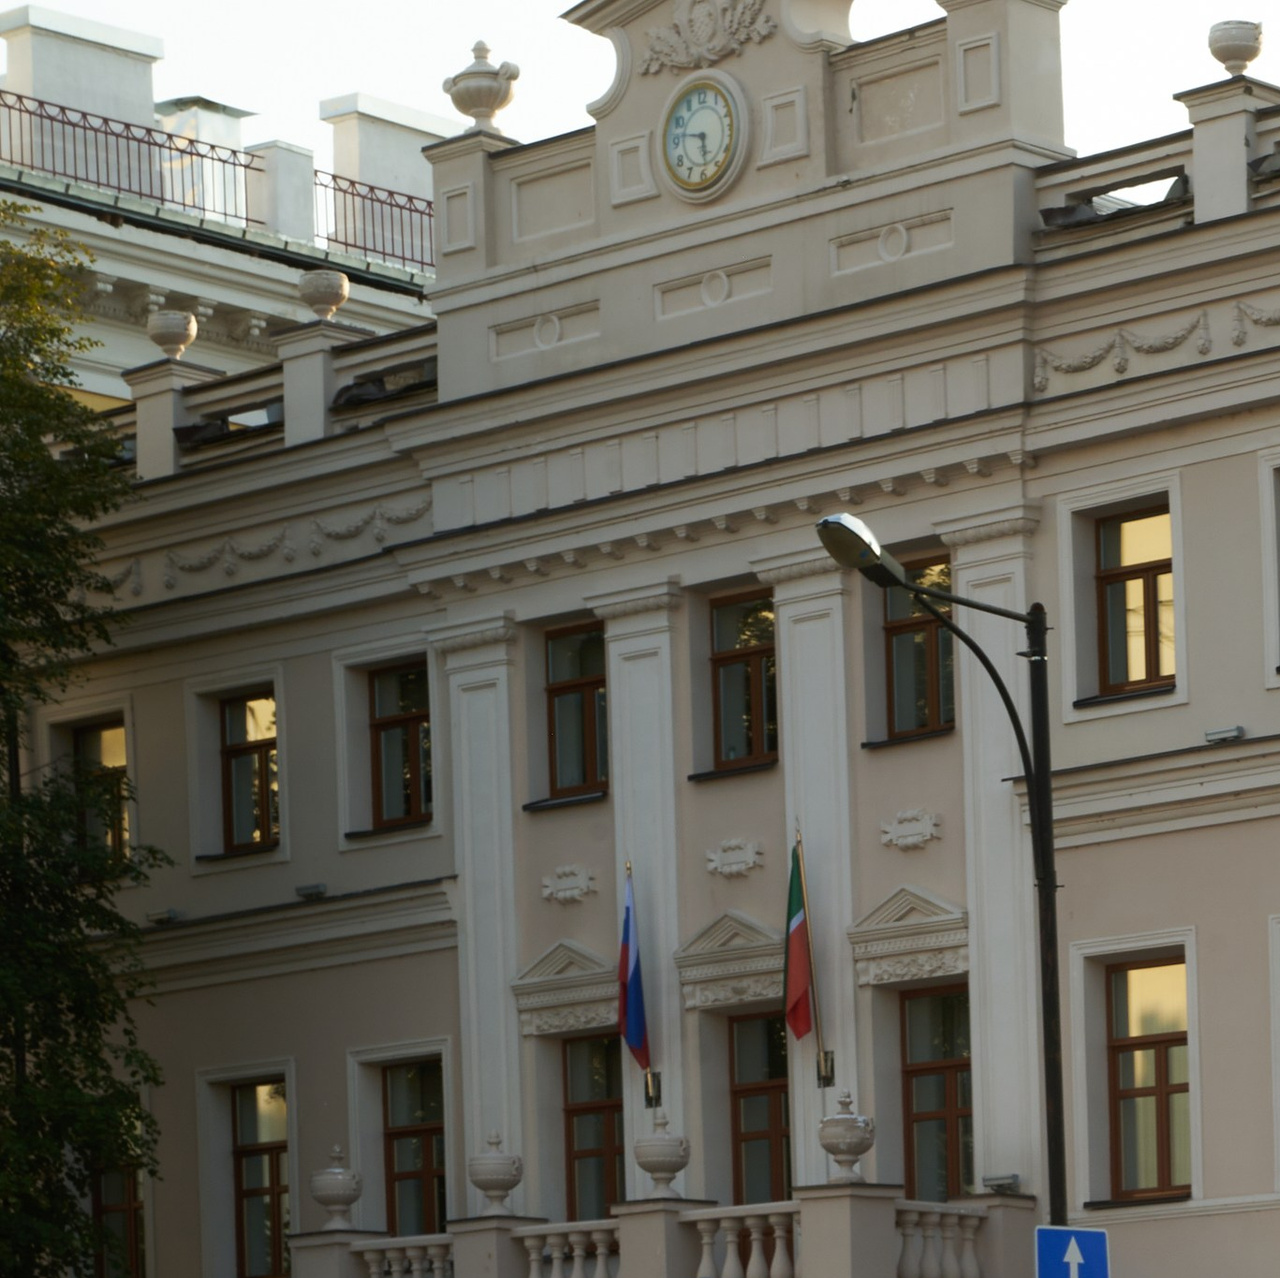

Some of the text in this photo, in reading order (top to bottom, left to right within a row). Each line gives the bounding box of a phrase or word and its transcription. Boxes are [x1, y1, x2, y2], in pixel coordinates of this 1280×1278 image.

[698, 88, 707, 105] 12
[675, 116, 685, 129] 10
[672, 134, 680, 150] 9
[677, 154, 684, 167] 8
[686, 166, 693, 179] 7
[700, 169, 707, 181] 6
